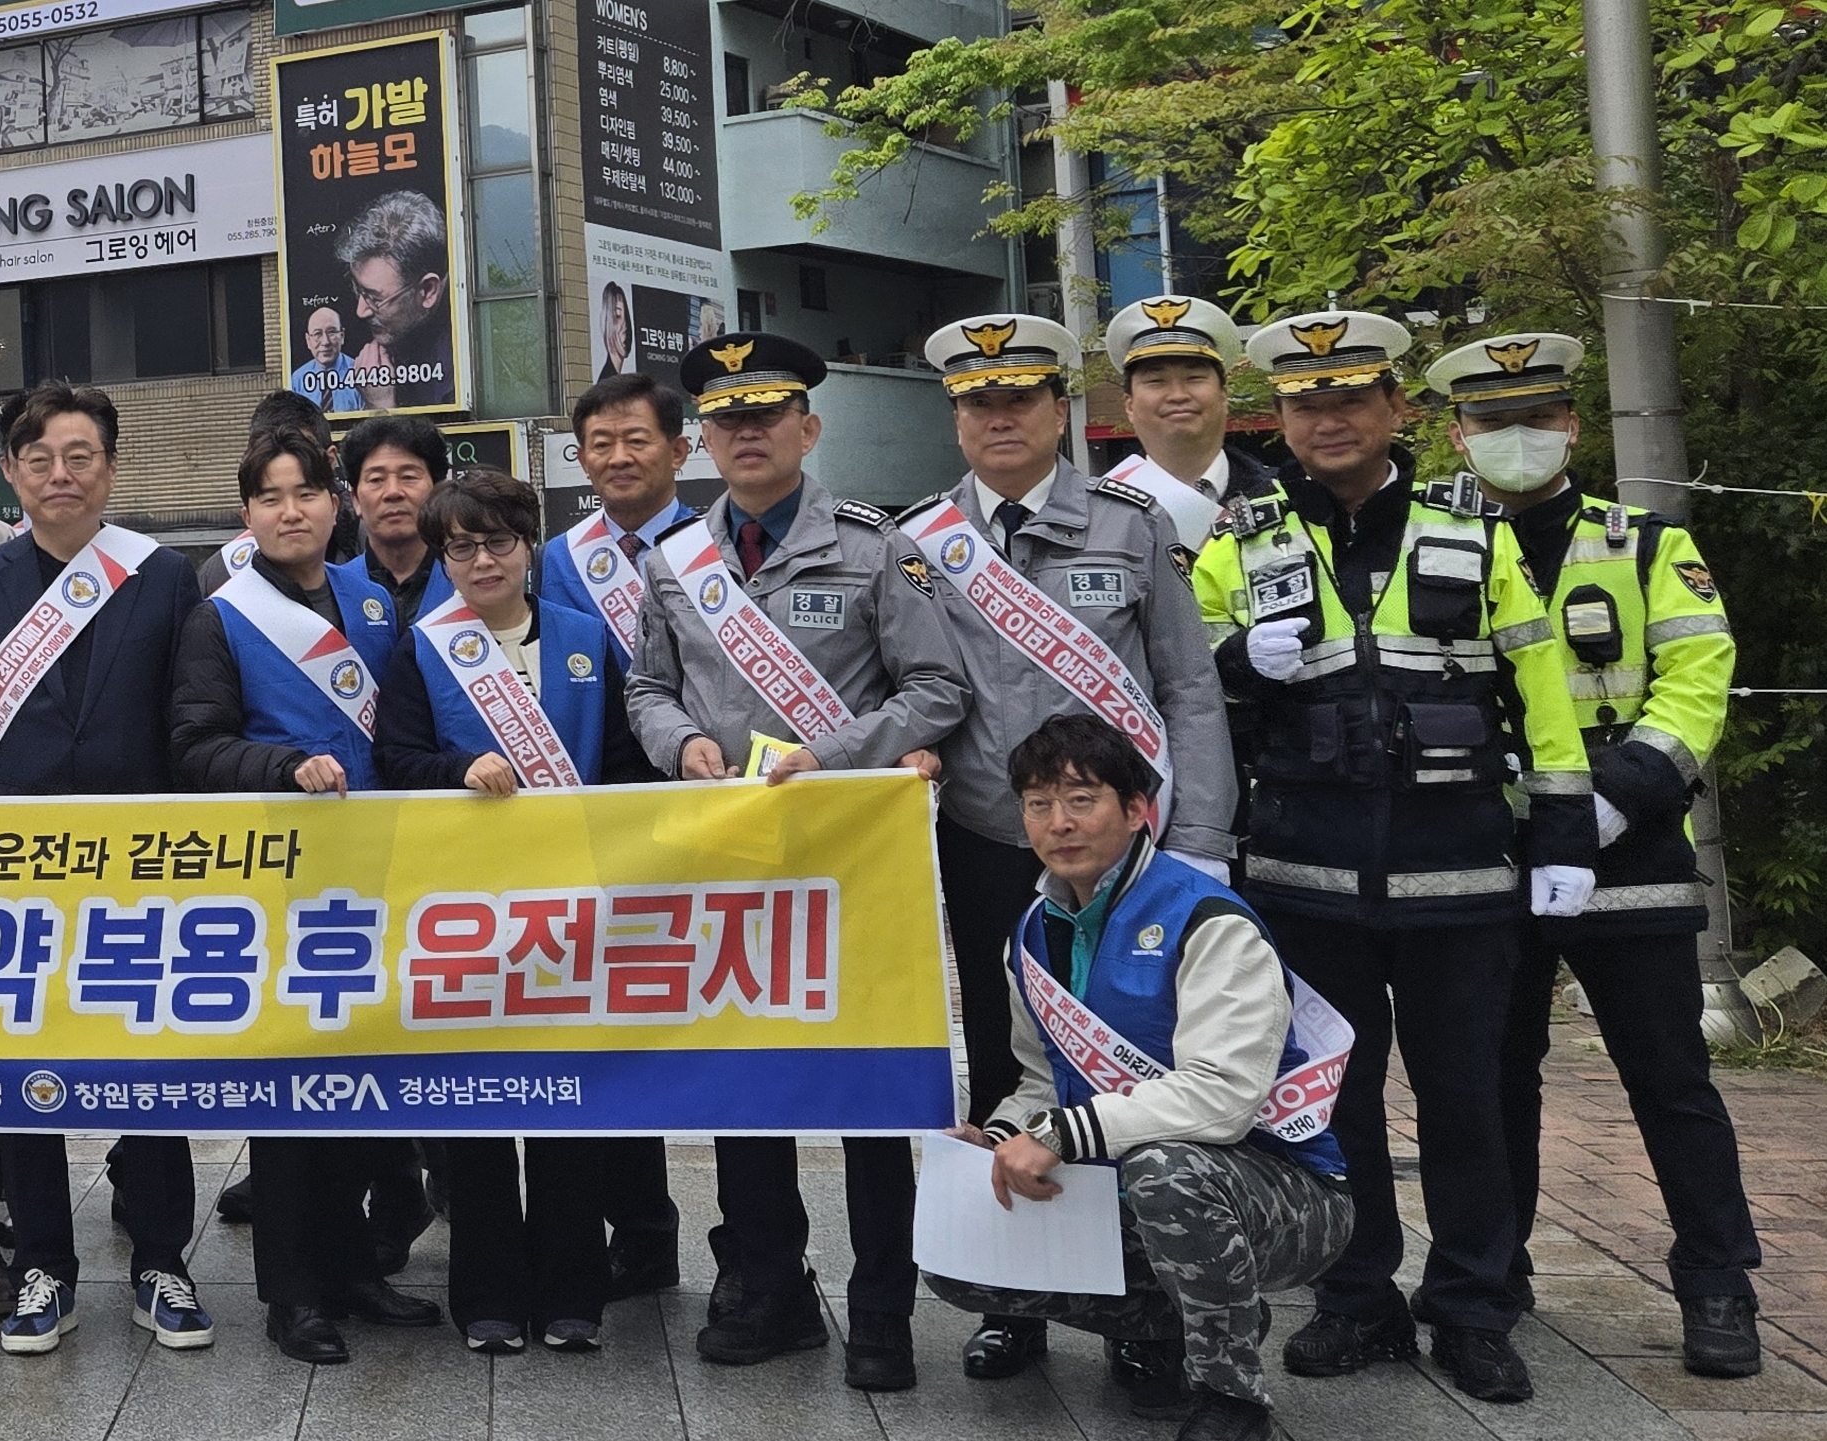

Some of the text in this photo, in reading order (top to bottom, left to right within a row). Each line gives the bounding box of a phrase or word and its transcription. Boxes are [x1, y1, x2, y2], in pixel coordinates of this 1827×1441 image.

[596, 0, 648, 31] WOMEN'S
[597, 60, 634, 89] 뿌리염색
[663, 56, 689, 80] 8,800
[294, 76, 429, 132] 특허 가발
[599, 86, 618, 110] 염색
[659, 80, 690, 104] 25,000
[660, 105, 691, 130] 39,500
[661, 130, 692, 155] 39,500
[309, 131, 418, 181] 하늘모
[662, 156, 694, 179] 44,000
[66, 172, 197, 229] SALON
[659, 181, 694, 205] 132,000
[85, 228, 197, 264] 그로잉 헤어
[0, 250, 55, 268] hair salon
[640, 327, 666, 350] 그로잉
[303, 362, 445, 393] 010.4448.9804
[1074, 573, 1119, 591] 경찰
[796, 593, 840, 613] 경찰
[1075, 593, 1121, 603] POLICE
[1260, 593, 1308, 613] POLICE
[794, 613, 840, 625] POLICE
[126, 829, 303, 881] 같습니다
[77, 905, 260, 1024] 복용
[285, 897, 378, 1020] 후
[409, 889, 829, 1020] 운전금지!
[73, 1078, 277, 1112] 창원중부경찰서
[397, 1075, 582, 1108] 경상남도약사회
